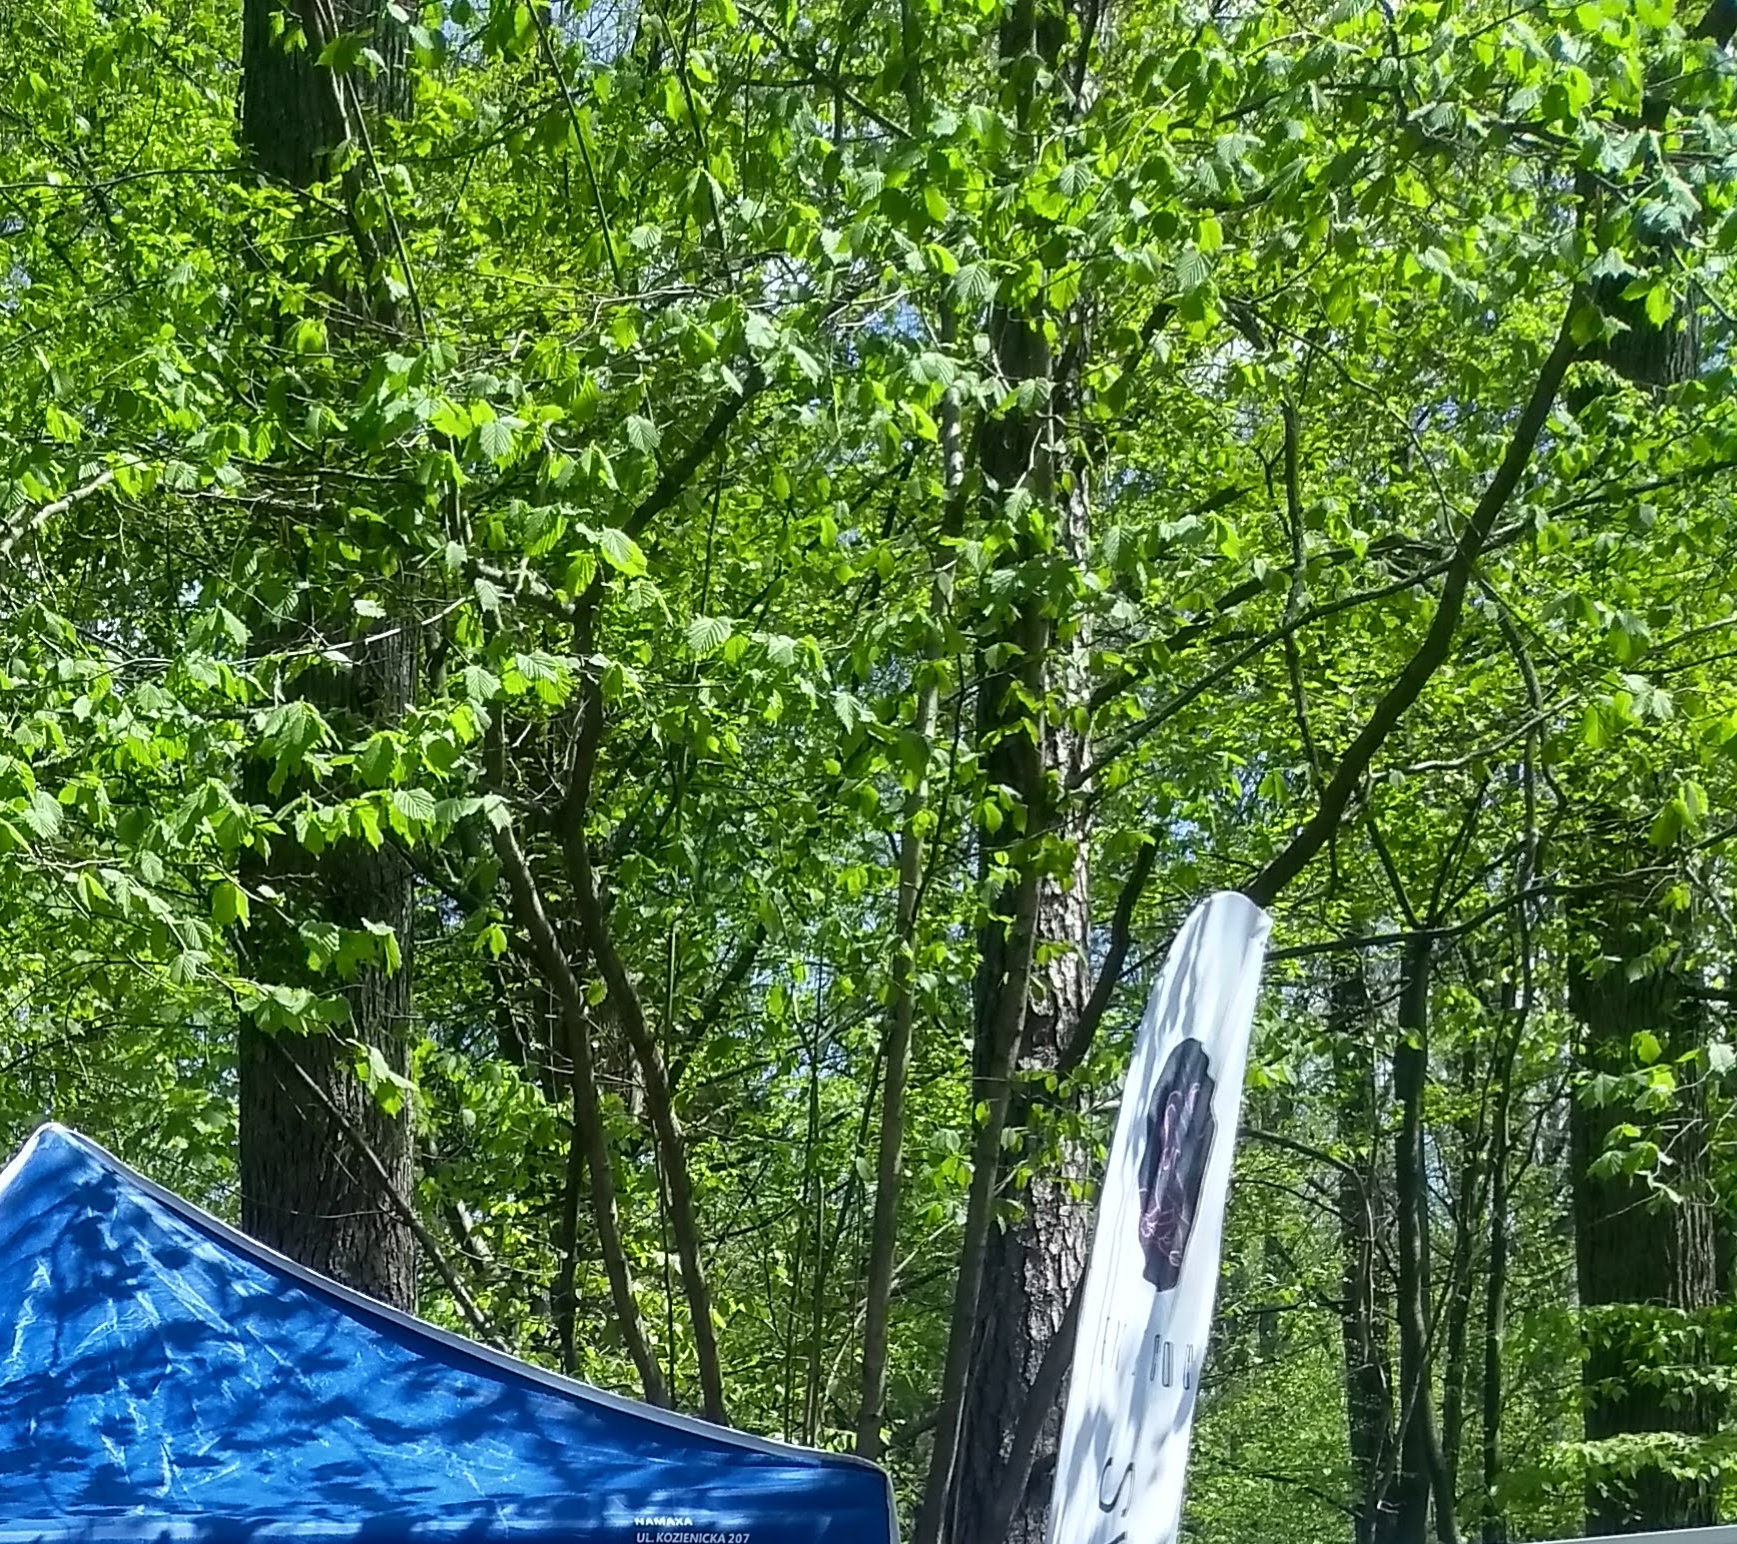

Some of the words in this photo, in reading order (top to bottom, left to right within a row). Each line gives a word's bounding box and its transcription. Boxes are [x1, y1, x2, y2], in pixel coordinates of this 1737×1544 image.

[634, 1517, 693, 1526] NAMAXA
[656, 1532, 726, 1544] KOZIENICKA
[728, 1533, 750, 1544] 207
